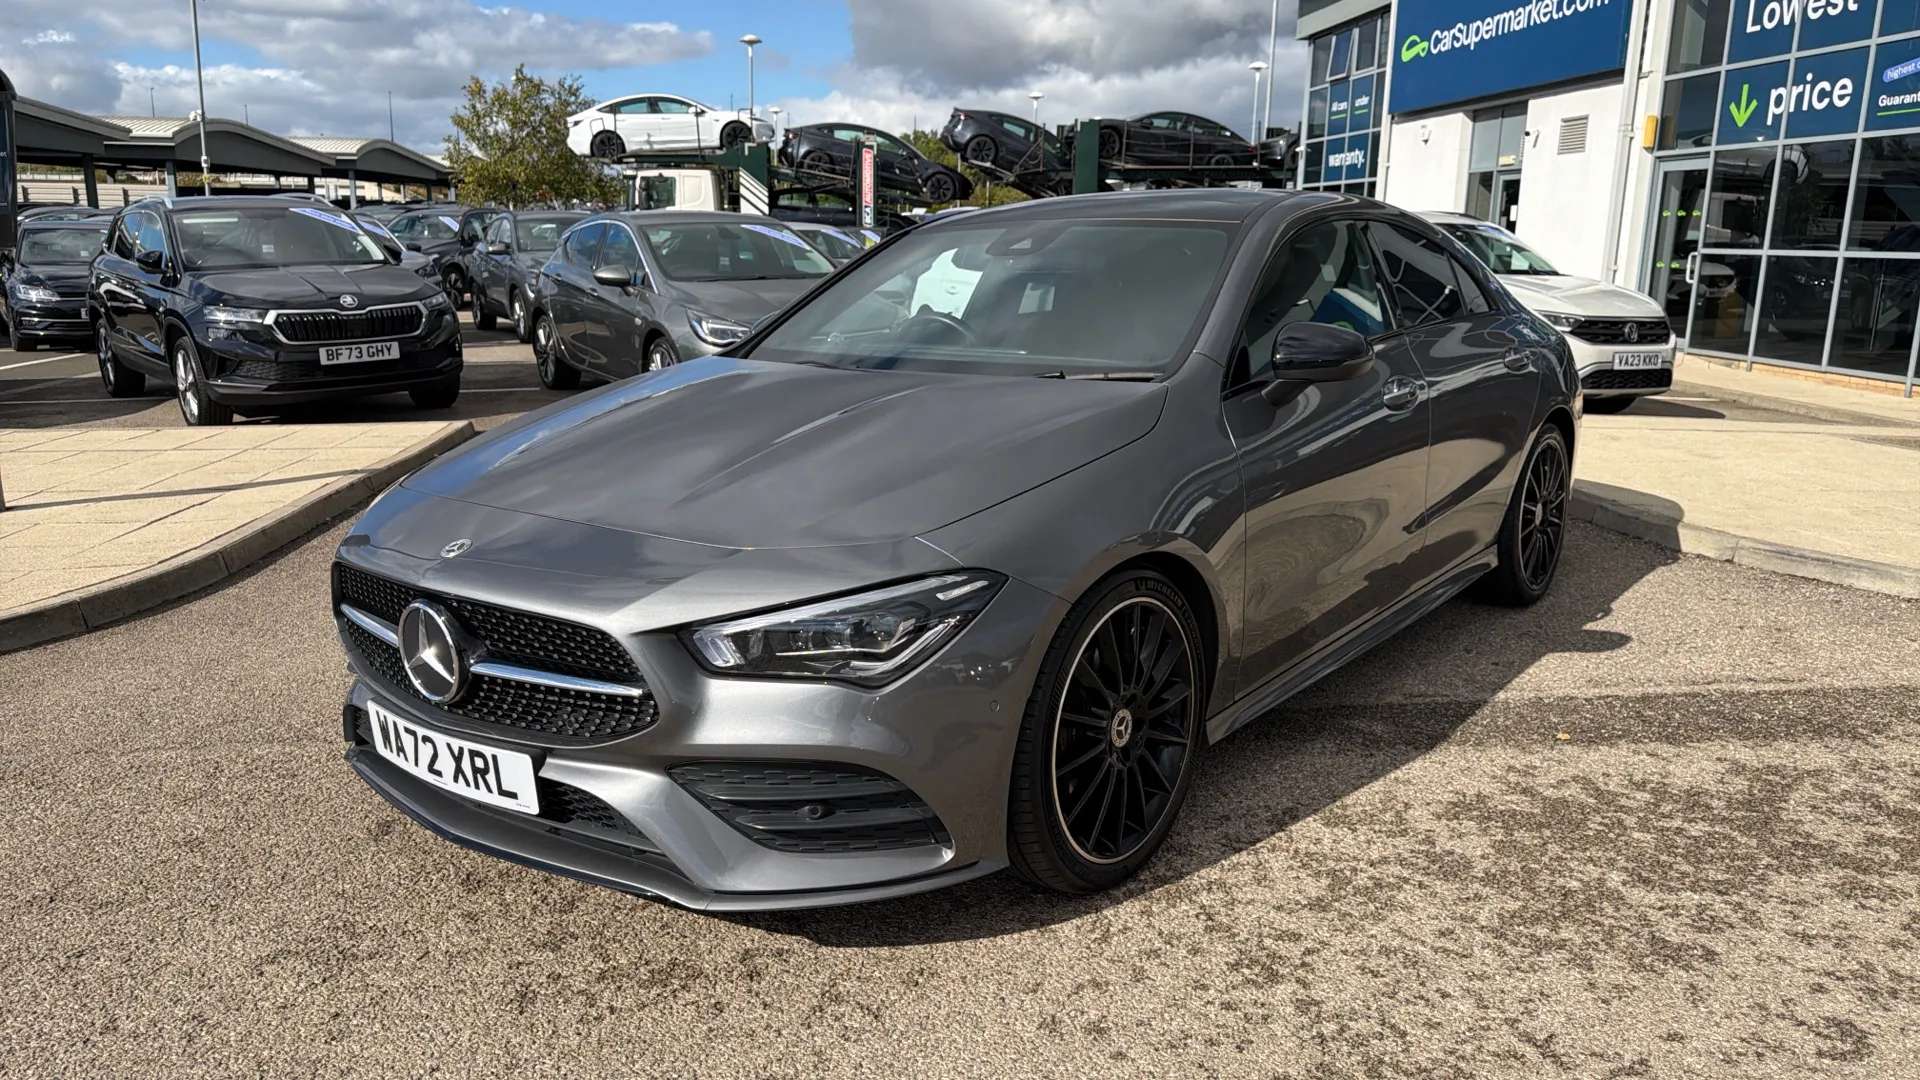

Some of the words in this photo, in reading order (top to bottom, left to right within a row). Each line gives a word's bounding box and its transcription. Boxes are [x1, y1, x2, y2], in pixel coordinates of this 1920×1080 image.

[1430, 0, 1608, 54] CarSupermarket.co
[1746, 0, 1858, 33] Lowes
[1766, 72, 1853, 125] price
[326, 347, 363, 361] BF73
[367, 344, 392, 358] GHY
[1618, 354, 1640, 367] VA23
[376, 710, 443, 778] WA72
[446, 742, 518, 800] XRL
